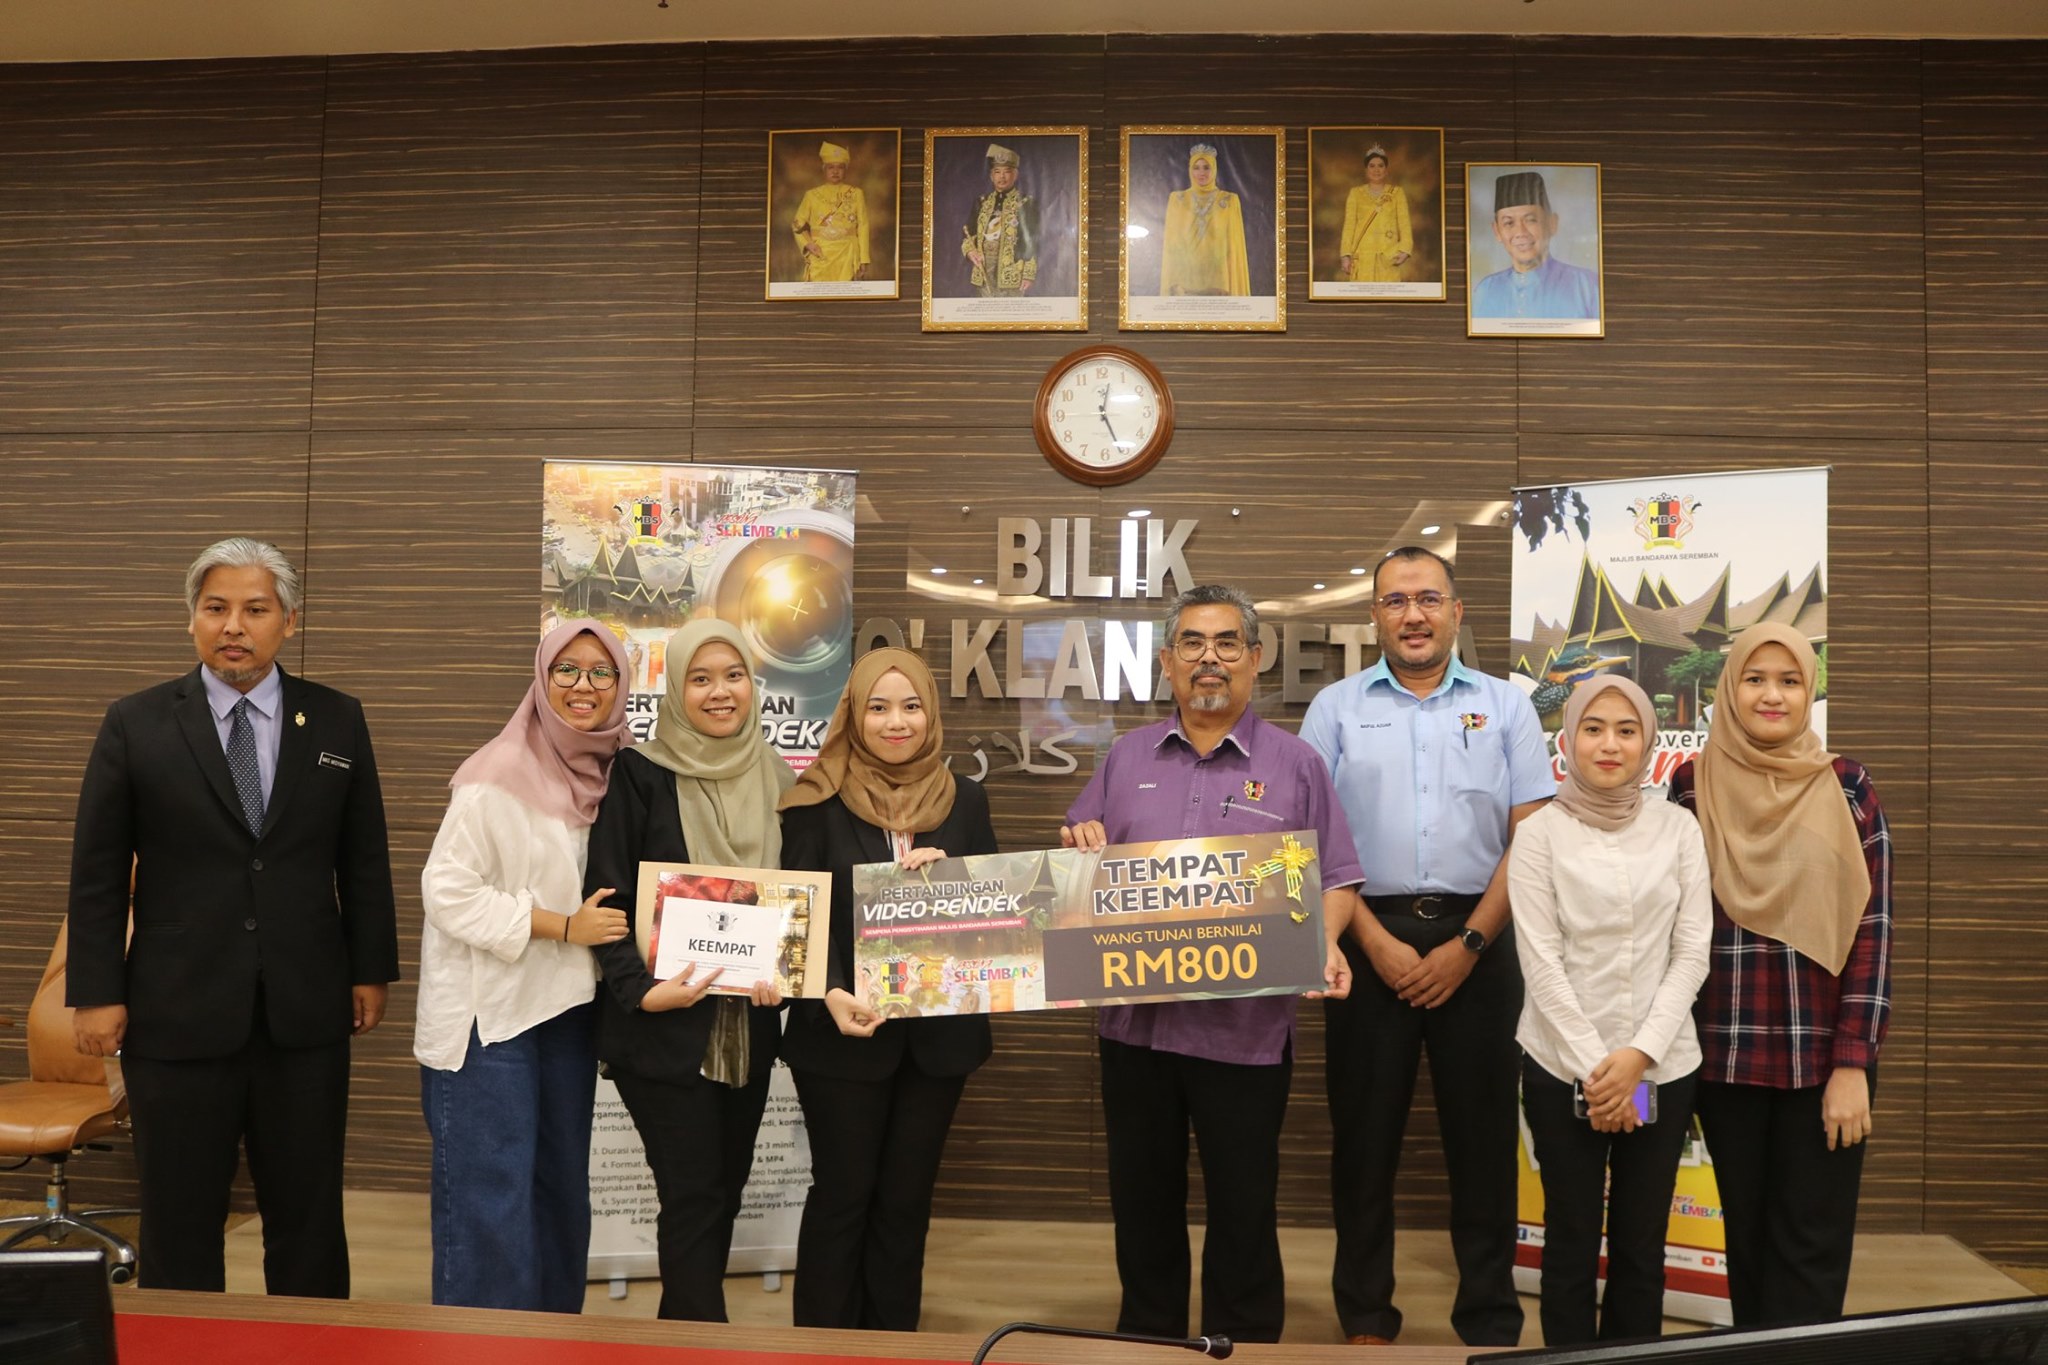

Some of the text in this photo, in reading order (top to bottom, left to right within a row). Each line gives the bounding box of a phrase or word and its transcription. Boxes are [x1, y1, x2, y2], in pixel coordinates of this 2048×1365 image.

[1096, 367, 1108, 379] 12
[1120, 372, 1126, 383] 1
[1076, 374, 1087, 386] 11
[1062, 389, 1073, 402] 10
[1056, 410, 1065, 422] 9
[1143, 406, 1151, 418] 3
[1064, 430, 1072, 443] 8
[1136, 426, 1145, 439] 4
[1080, 444, 1088, 456] 7
[1101, 448, 1110, 461] 6
[634, 516, 658, 524] MBS
[1650, 515, 1677, 524] MBS
[716, 523, 799, 540] SEREMBAN
[997, 517, 1199, 597] BILIK
[1102, 851, 1247, 885] TEMPAT
[881, 880, 1004, 900] PERTANDINGAN
[1094, 880, 1257, 915] KEEMPAT
[862, 893, 1023, 921] VIDEO PENDEK
[865, 928, 891, 936] SEMPENA
[938, 923, 958, 931] MAJLIS
[959, 922, 990, 930] BANDARAYA
[991, 919, 1022, 928] SEREMBAN
[1093, 923, 1262, 946] WANG TUNAI BERNILAI
[688, 938, 756, 957] KEEMPAT
[1102, 942, 1258, 988] RM800
[882, 975, 905, 984] MBS
[954, 967, 1034, 983] SEREMBAN
[600, 1124, 632, 1132] terbuka
[768, 1167, 811, 1175] hendaklah
[778, 1177, 814, 1186] Malaysia
[611, 1197, 638, 1206] Syarat
[763, 1191, 785, 1200] layari
